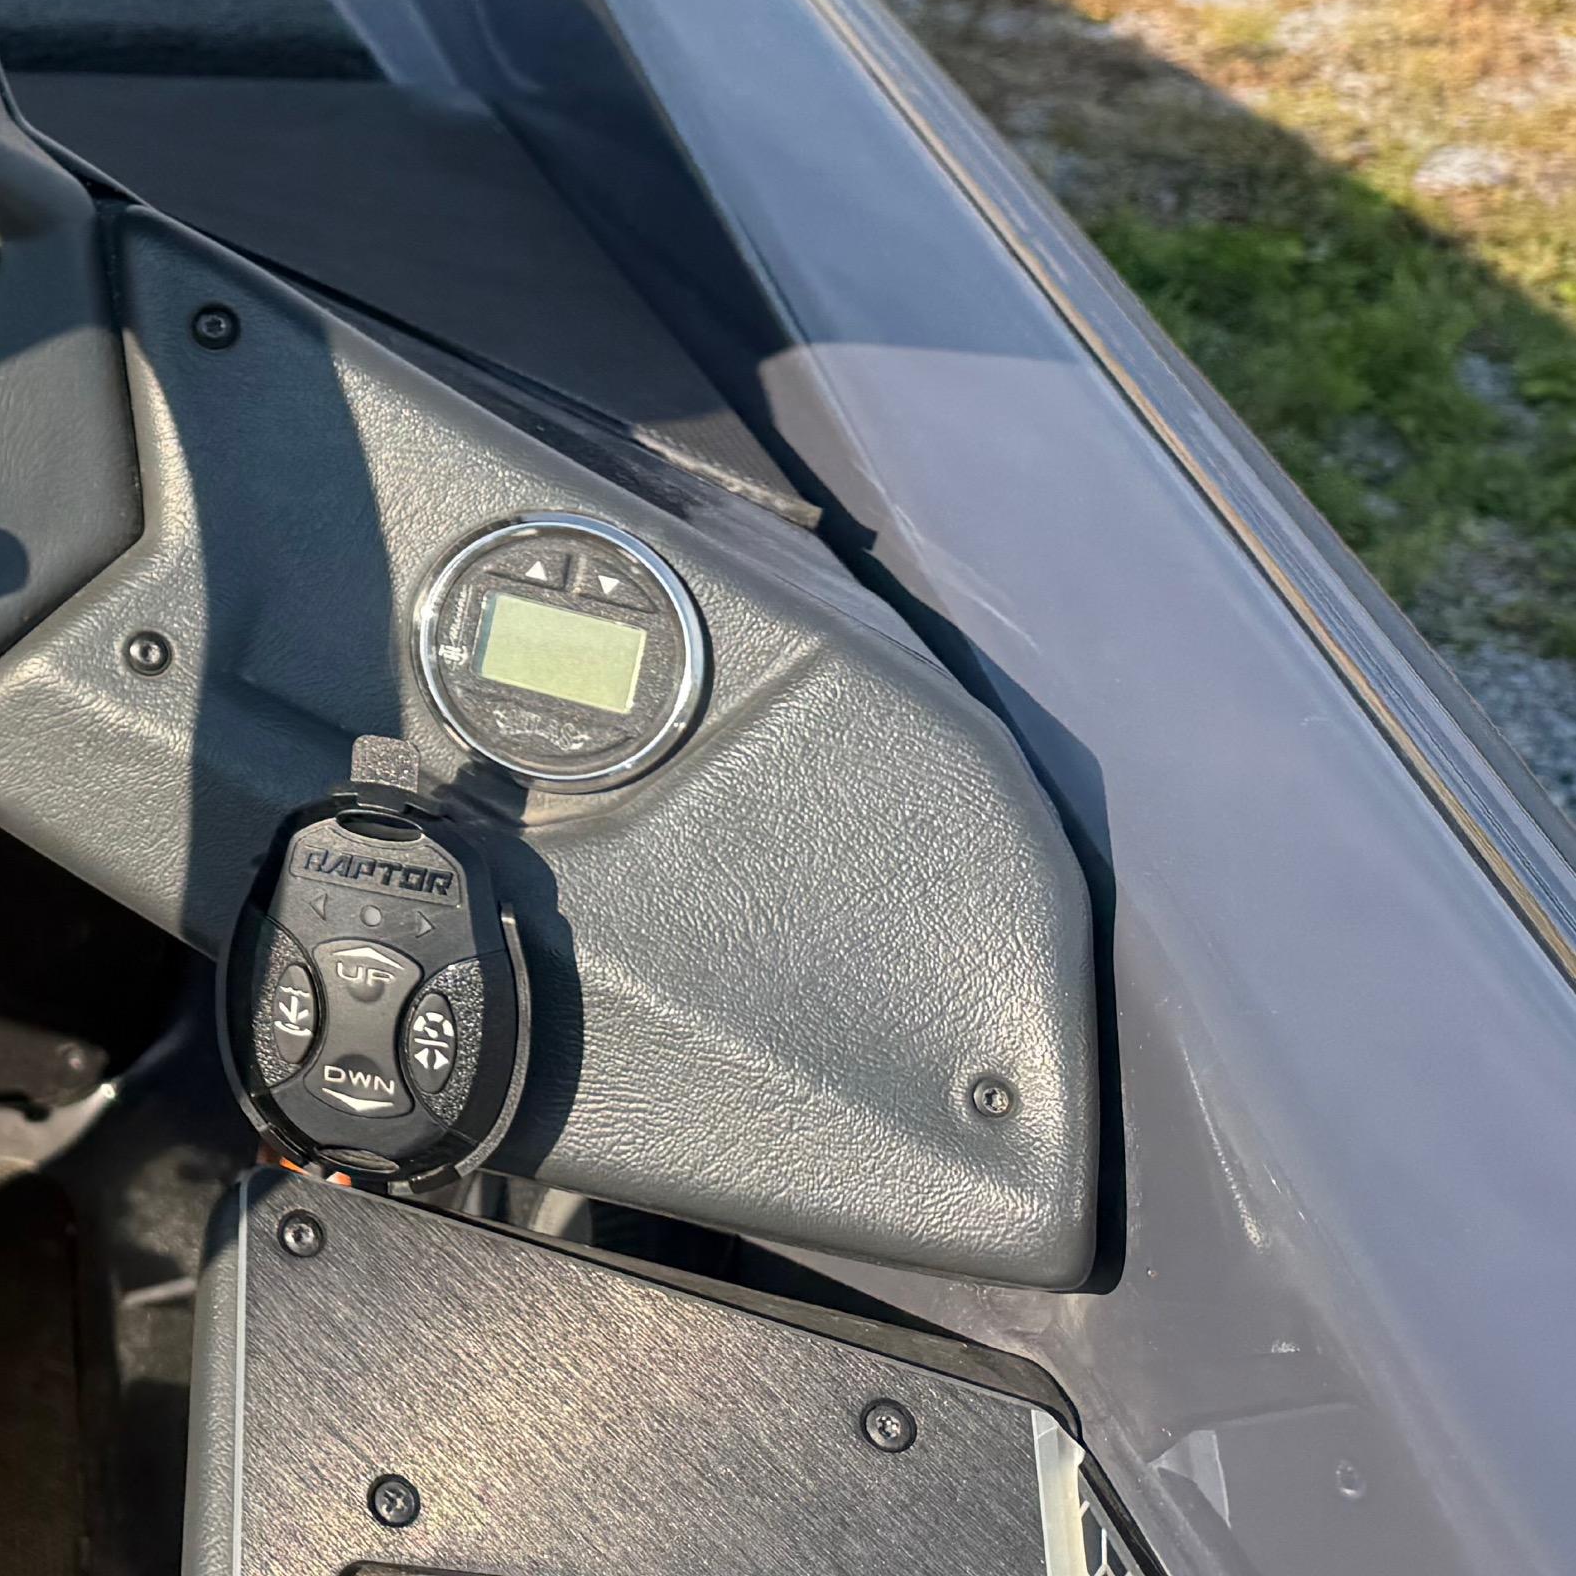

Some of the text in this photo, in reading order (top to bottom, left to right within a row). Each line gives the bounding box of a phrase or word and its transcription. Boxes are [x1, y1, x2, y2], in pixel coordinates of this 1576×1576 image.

[304, 847, 453, 896] RAPTOR
[336, 961, 395, 986] UP
[323, 1065, 395, 1095] DWN
